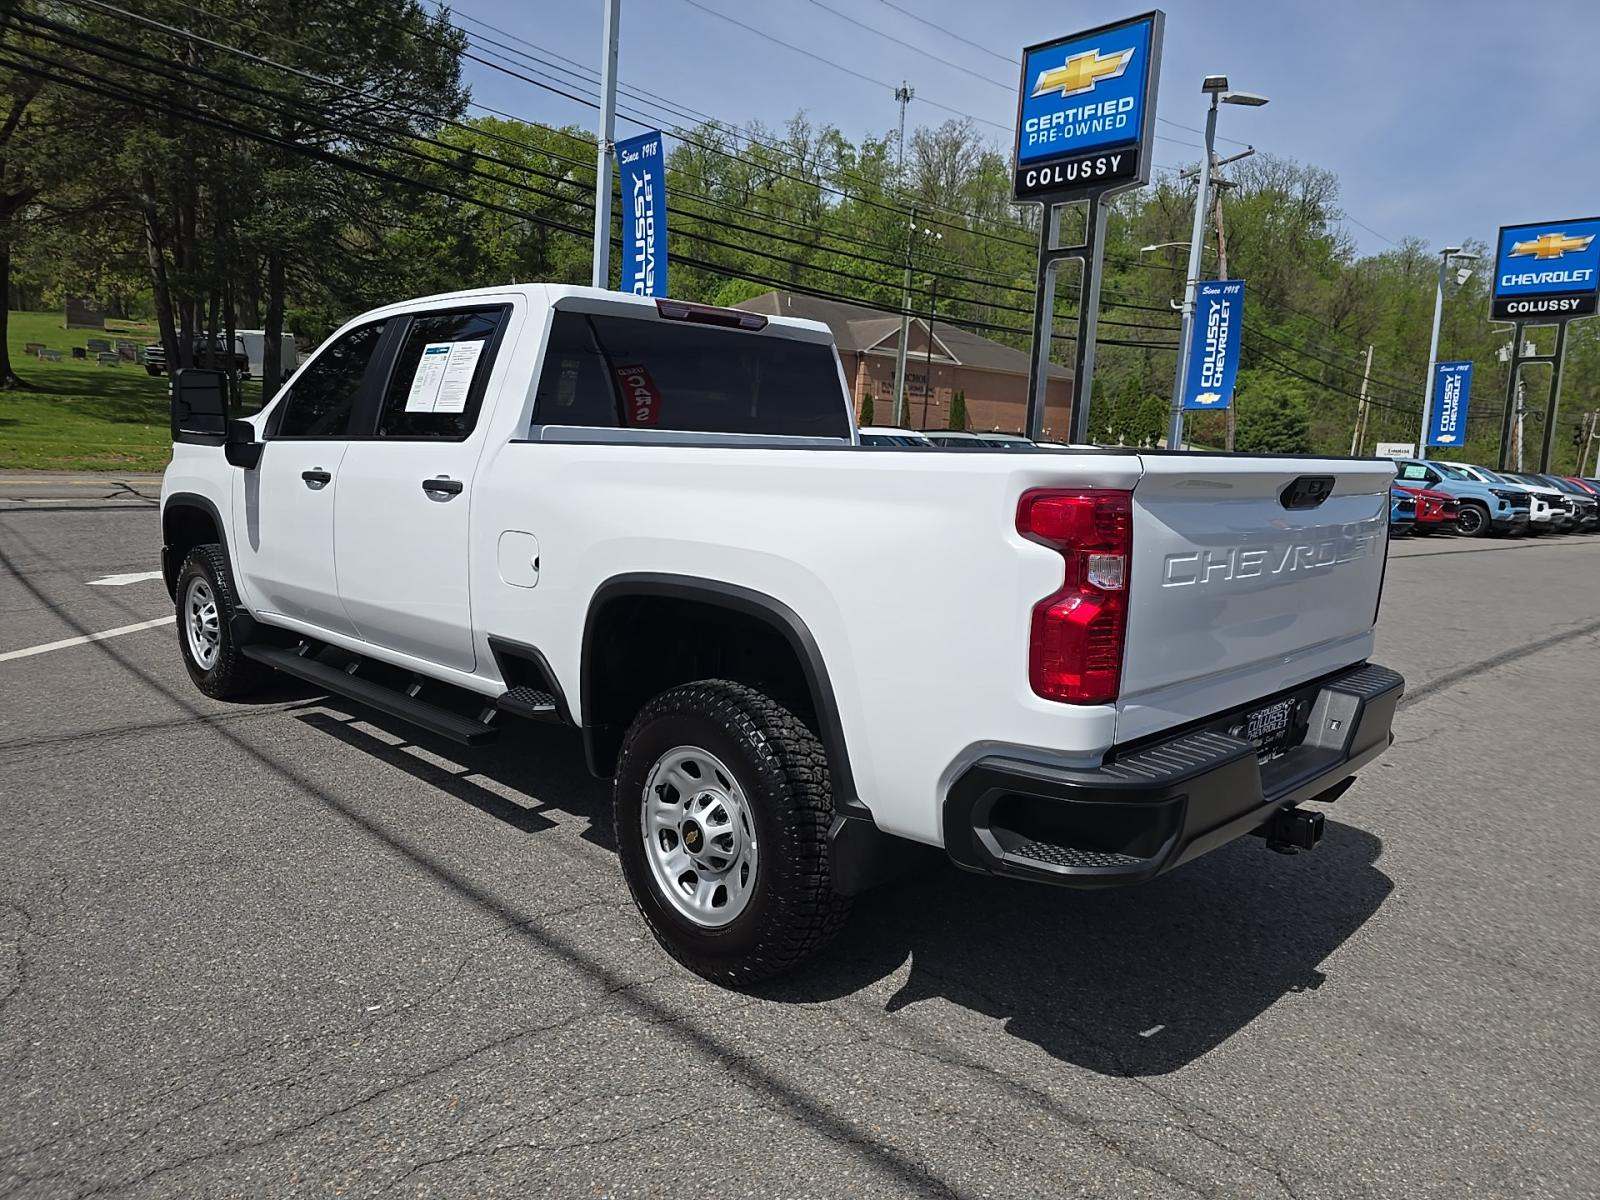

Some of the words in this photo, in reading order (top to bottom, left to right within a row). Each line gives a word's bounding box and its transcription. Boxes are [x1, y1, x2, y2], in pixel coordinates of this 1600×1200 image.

[1025, 96, 1134, 133] CERTIFIED
[1028, 114, 1127, 146] PRE-OWNED
[622, 150, 640, 165] Since
[642, 142, 658, 159] 1918
[1026, 154, 1122, 187] COLUSSY
[633, 172, 646, 297] OLUSSY
[1202, 286, 1220, 295] Since
[1223, 286, 1240, 294] 1918
[1501, 268, 1594, 287] CHEVROLET
[1507, 298, 1580, 313] COLUSSY
[1201, 299, 1220, 387] COLUSSY
[1213, 299, 1230, 387] CHEVROLET
[1440, 375, 1454, 432] COLUSSY
[1448, 374, 1461, 432] CHEVROLET
